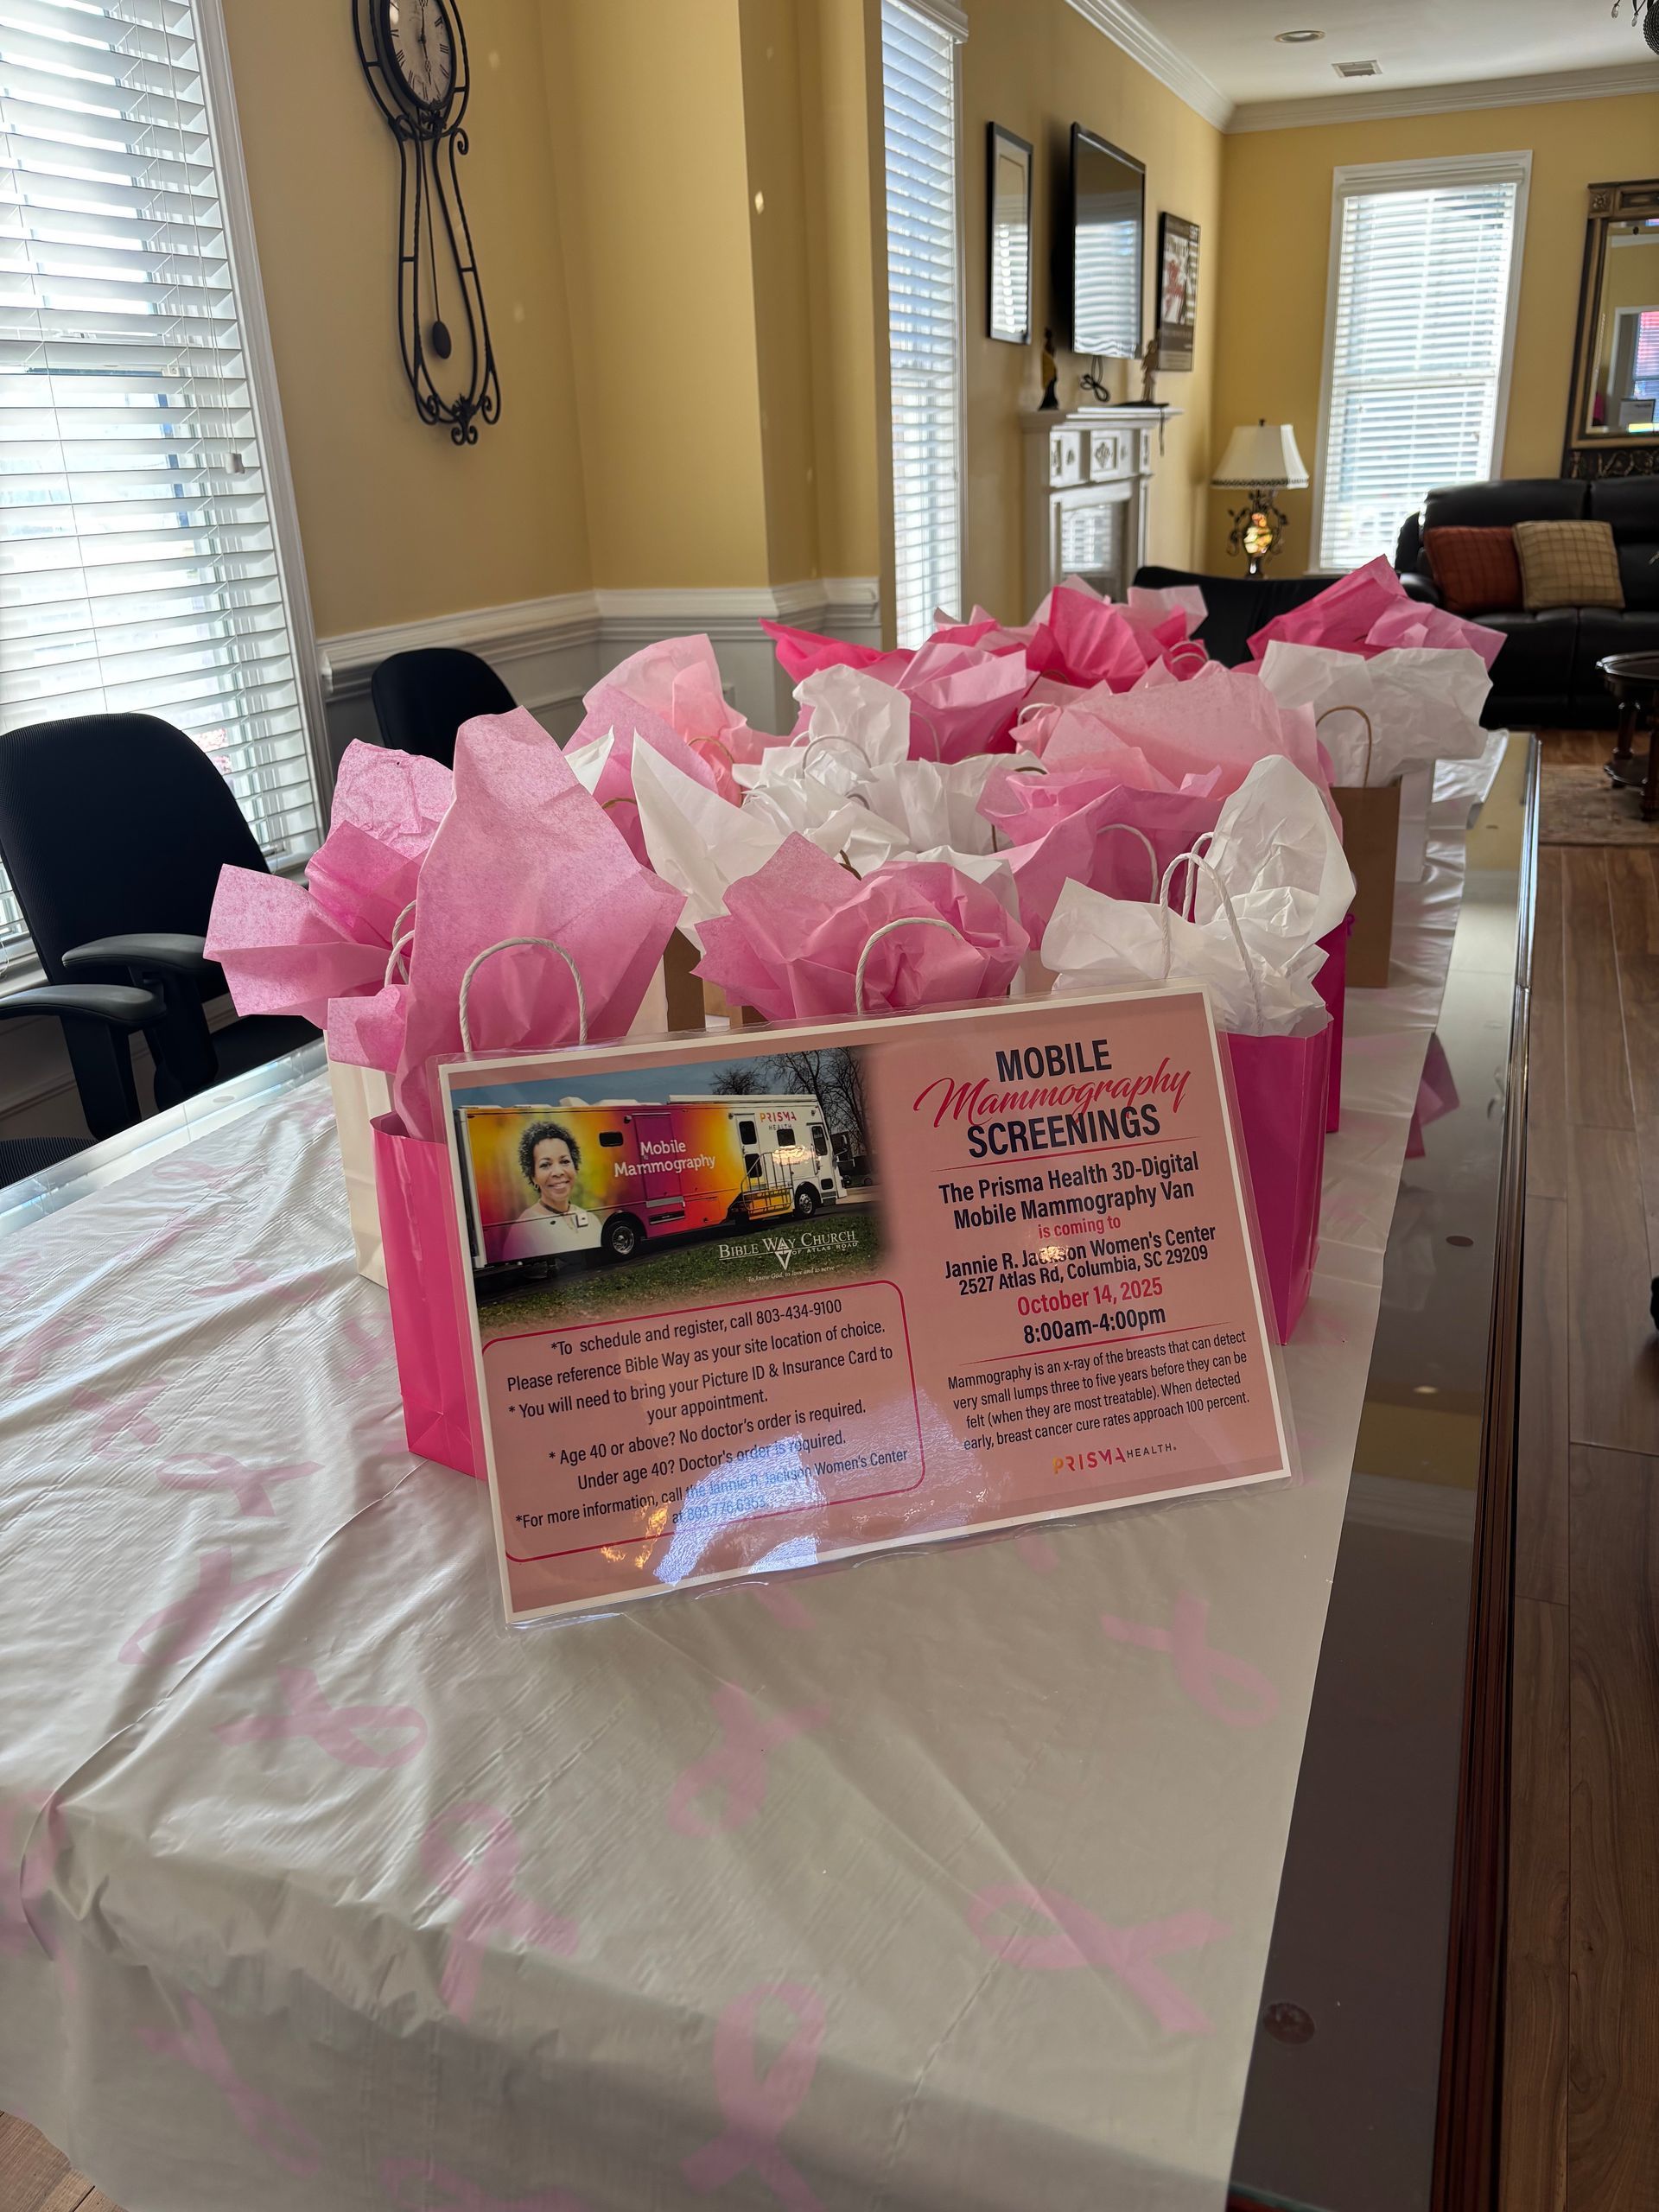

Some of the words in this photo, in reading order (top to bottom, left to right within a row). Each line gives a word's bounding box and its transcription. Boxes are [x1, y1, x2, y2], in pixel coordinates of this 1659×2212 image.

[995, 1039, 1112, 1082] MOBILE
[760, 1111, 797, 1123] PRISMA
[913, 1058, 1191, 1128] Mammography
[640, 1140, 686, 1156] Mobile
[967, 1104, 1160, 1158] SCREENINGS
[614, 1154, 715, 1178] Mammography
[938, 1184, 974, 1204] The
[979, 1174, 1044, 1198] Prisma
[1048, 1164, 1108, 1188] Health
[1113, 1151, 1199, 1181] 3D-Digital
[954, 1206, 1016, 1230] Mobile
[1021, 1188, 1157, 1220] Mammography
[1160, 1183, 1194, 1200] Van
[1039, 1224, 1051, 1239] is
[1054, 1220, 1104, 1237] coming
[1107, 1216, 1122, 1230] to
[719, 1243, 759, 1258] BIBLE
[762, 1237, 796, 1251] WAY
[801, 1230, 855, 1247] CHURCH
[945, 1255, 998, 1279] Jannie
[1002, 1253, 1018, 1270] R.
[1090, 1231, 1161, 1257] Women's
[1166, 1225, 1216, 1246] Center
[959, 1277, 994, 1295] 2527
[999, 1270, 1036, 1289] Atlas
[1039, 1266, 1064, 1286] Rd,
[1067, 1256, 1141, 1280] Columbia,
[1143, 1252, 1163, 1268] SC
[1166, 1245, 1208, 1266] 29209
[1018, 1288, 1090, 1315] October
[1093, 1285, 1116, 1306] 14,
[1122, 1277, 1163, 1301] 2025
[581, 1330, 641, 1352] schedule
[645, 1325, 670, 1342] and
[674, 1319, 728, 1339] register,
[730, 1312, 753, 1328] call
[756, 1299, 842, 1325] 803-434-9100
[1024, 1307, 1166, 1344] 8:00am-4:00pm
[507, 1374, 552, 1392] Please
[557, 1363, 620, 1383] reference
[626, 1355, 658, 1373] Bible
[662, 1351, 690, 1367] Way
[694, 1350, 709, 1362] as
[712, 1344, 741, 1363] your
[745, 1338, 768, 1354] site
[771, 1331, 822, 1350] location
[825, 1326, 837, 1341] of
[841, 1322, 885, 1338] choice.
[519, 1403, 544, 1418] You
[549, 1395, 572, 1413] will
[576, 1390, 610, 1409] need
[613, 1389, 626, 1402] to
[630, 1383, 665, 1401] bring
[669, 1378, 699, 1397] your
[702, 1370, 748, 1389] Picture
[752, 1365, 765, 1381] ID
[769, 1363, 779, 1377] &
[782, 1354, 845, 1376] Insurance
[849, 1346, 877, 1364] Card
[880, 1345, 893, 1359] to
[948, 1365, 1032, 1389] Mammography
[1035, 1362, 1044, 1375] is
[1047, 1362, 1061, 1373] an
[1064, 1357, 1090, 1371] x-ray
[1093, 1355, 1103, 1366] of
[1106, 1352, 1123, 1363] the
[1126, 1344, 1166, 1361] breasts
[1168, 1341, 1189, 1355] that
[1192, 1338, 1211, 1351] can
[1213, 1331, 1246, 1346] detect
[953, 1395, 977, 1410] very
[982, 1389, 1011, 1406] small
[1014, 1384, 1048, 1402] lumps
[1051, 1379, 1080, 1395] three
[1083, 1376, 1093, 1389] to
[1096, 1372, 1116, 1387] five
[1118, 1369, 1148, 1386] years
[1151, 1360, 1185, 1377] before
[1186, 1359, 1210, 1374] they
[1212, 1355, 1230, 1368] can
[1233, 1351, 1247, 1363] be
[647, 1406, 677, 1425] your
[681, 1389, 768, 1418] appointment.
[963, 1434, 994, 1451] early,
[997, 1427, 1033, 1445] breast
[1035, 1424, 1073, 1439] cancer
[1076, 1418, 1101, 1432] cure
[1103, 1413, 1131, 1427] rates
[1134, 1404, 1184, 1424] approach
[1186, 1399, 1204, 1413] 100
[1207, 1393, 1249, 1412] percent.
[967, 1414, 985, 1429] felt
[988, 1408, 1023, 1427] (when
[1026, 1404, 1050, 1420] they
[1053, 1402, 1071, 1414] are
[1074, 1397, 1102, 1410] most
[1104, 1384, 1160, 1407] treatable).
[1161, 1382, 1192, 1397] When
[1195, 1371, 1241, 1391] detected
[560, 1449, 586, 1465] Age
[590, 1444, 607, 1459] 40
[611, 1443, 624, 1456] or
[628, 1432, 676, 1452] above?
[679, 1429, 697, 1444] No
[701, 1419, 753, 1440] doctor's
[757, 1414, 791, 1430] order
[795, 1410, 806, 1424] is
[809, 1399, 866, 1423] required.
[577, 1471, 619, 1490] Under
[623, 1467, 648, 1484] age
[651, 1459, 675, 1476] 40?
[679, 1449, 733, 1472] Doctor's
[737, 1443, 771, 1460] order
[775, 1440, 785, 1453] is
[789, 1430, 846, 1452] required.
[1052, 1446, 1126, 1474] PRISMA
[548, 1508, 580, 1524] more
[583, 1495, 658, 1517] information,
[661, 1487, 683, 1503] call
[685, 1484, 706, 1498] the
[814, 1456, 867, 1475] Women's
[870, 1450, 908, 1465] Center
[672, 1511, 683, 1523] at
